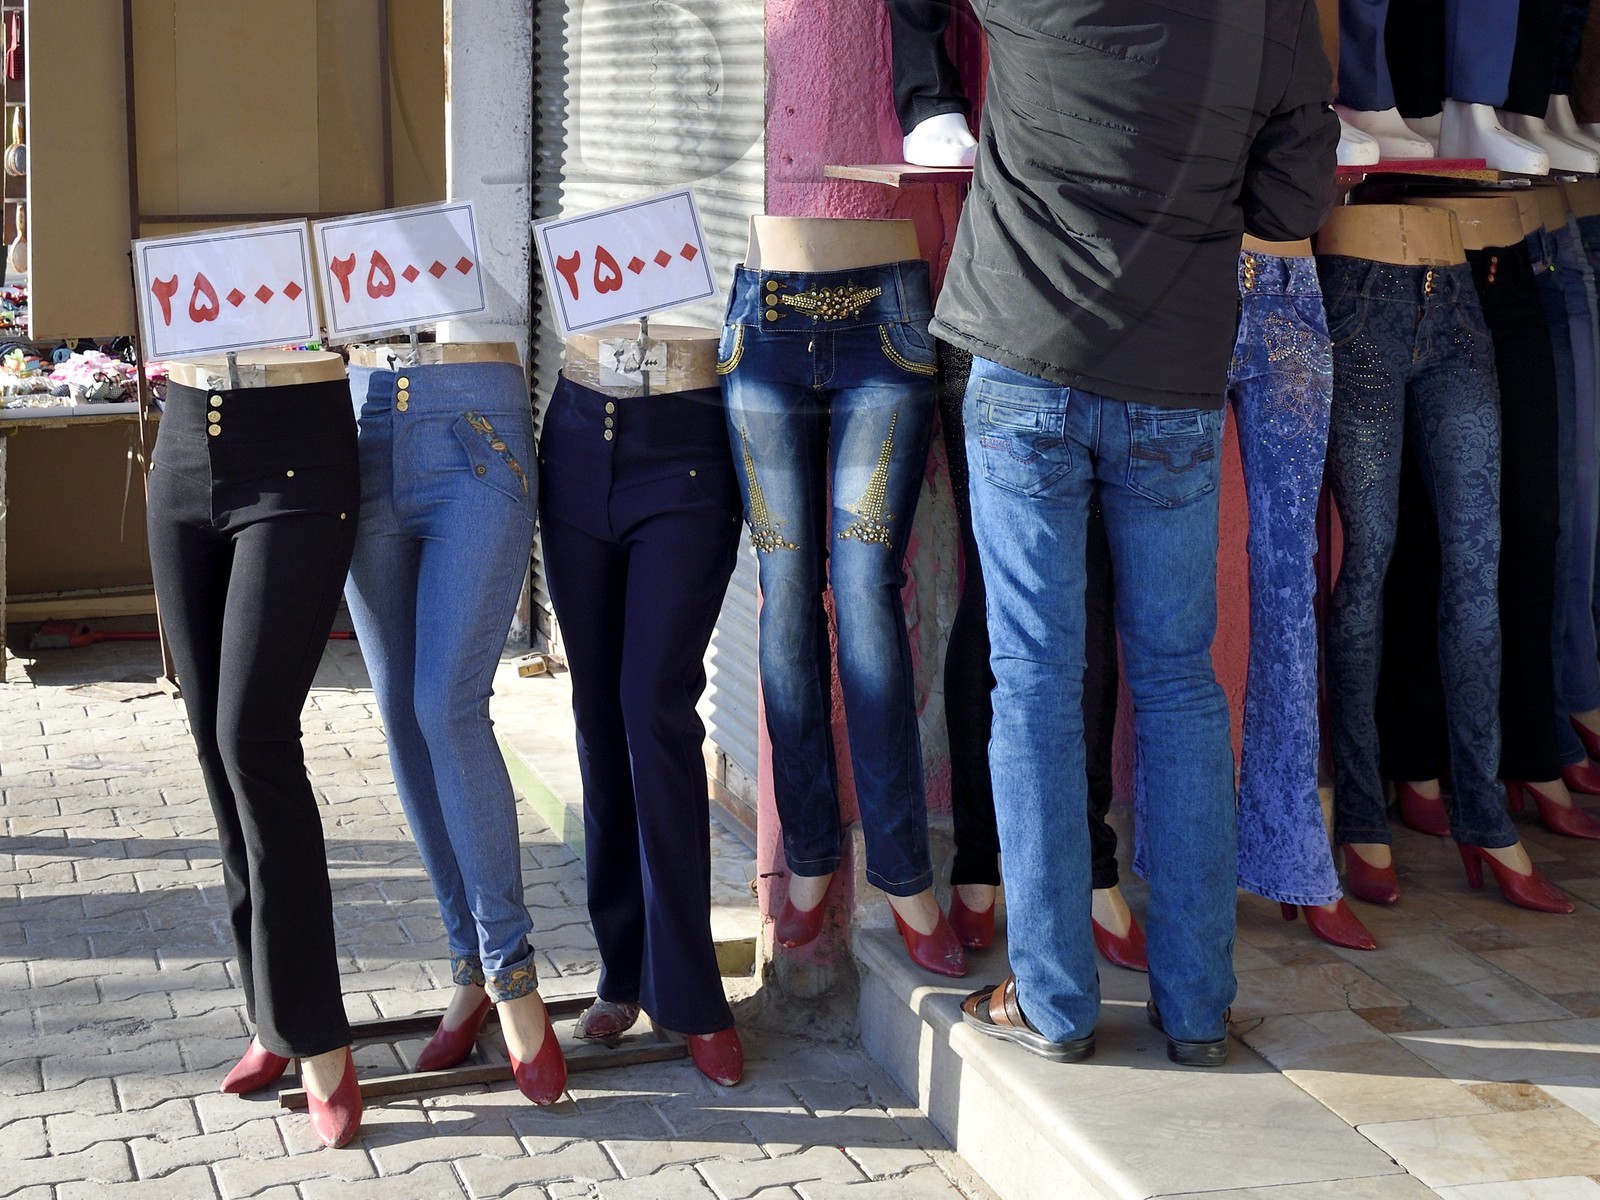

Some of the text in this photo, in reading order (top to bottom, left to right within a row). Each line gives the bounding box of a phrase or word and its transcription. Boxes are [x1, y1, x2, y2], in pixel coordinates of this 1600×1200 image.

[151, 271, 302, 327] ۲۵۰۰۰
[330, 249, 474, 303] ۲۵۰۰۰
[556, 242, 698, 301] ۲۵۰۰۰
